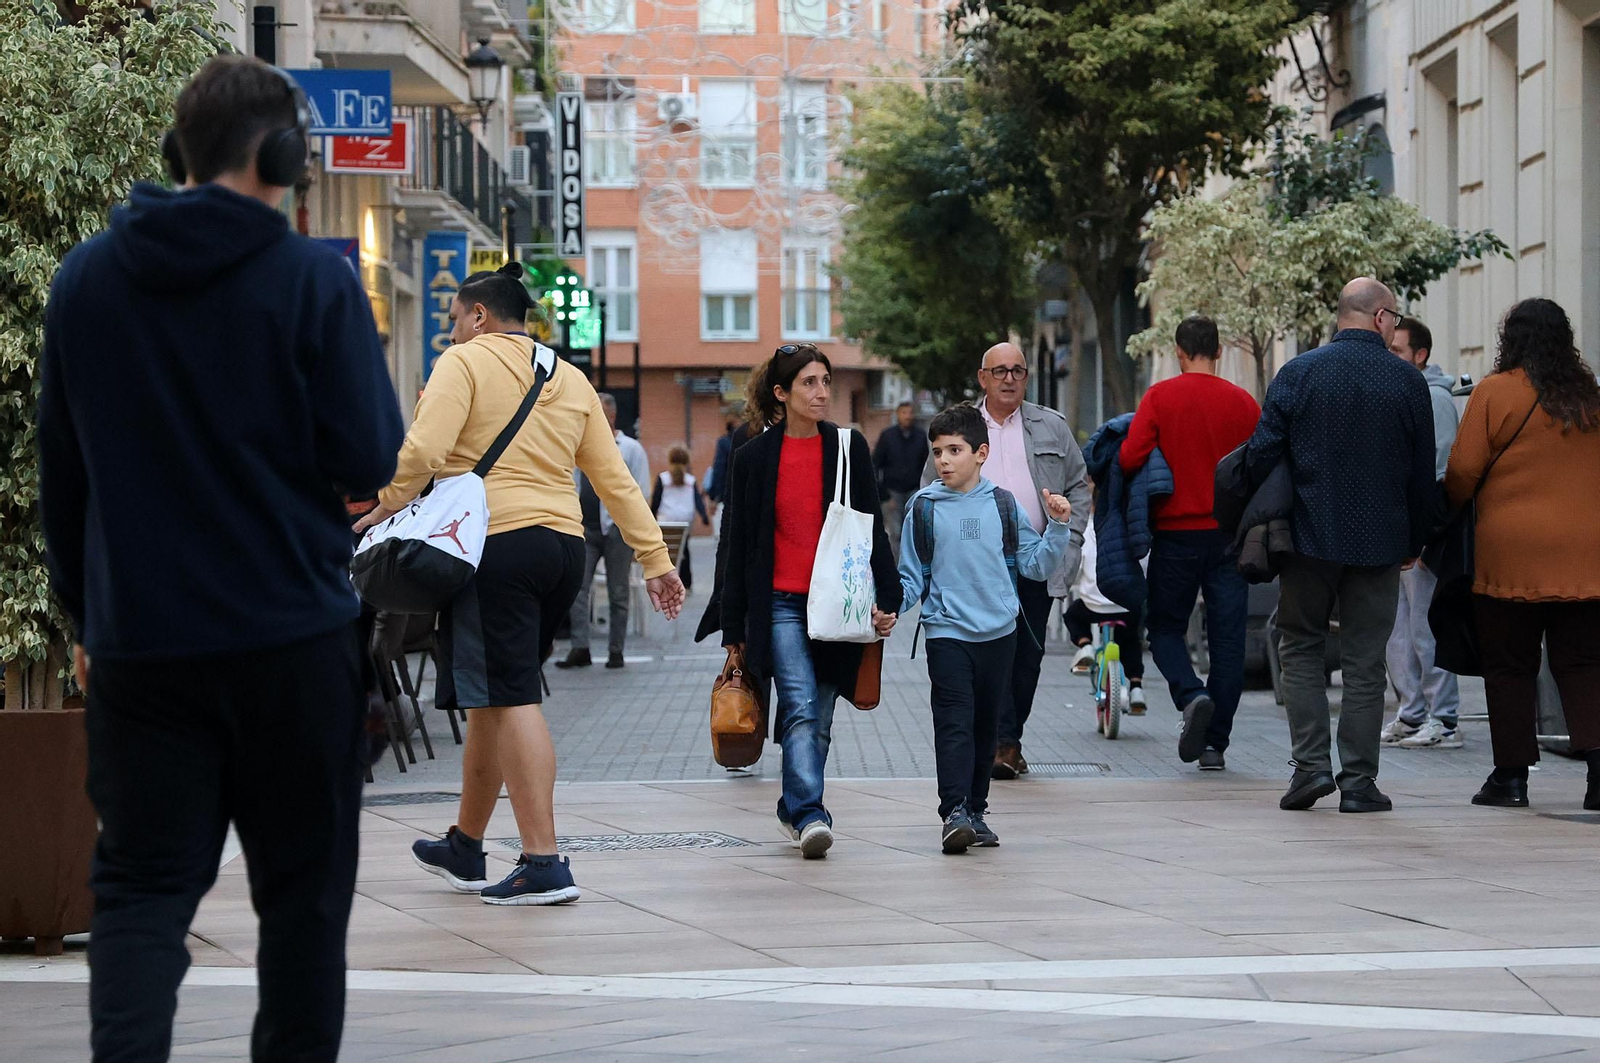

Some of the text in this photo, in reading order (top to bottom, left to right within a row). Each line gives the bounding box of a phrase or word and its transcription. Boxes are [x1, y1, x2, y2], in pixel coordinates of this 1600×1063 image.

[561, 96, 581, 254] VIDOSA
[429, 249, 459, 370] TATTO
[962, 520, 978, 529] GOOD
[963, 530, 979, 539] TIMES
